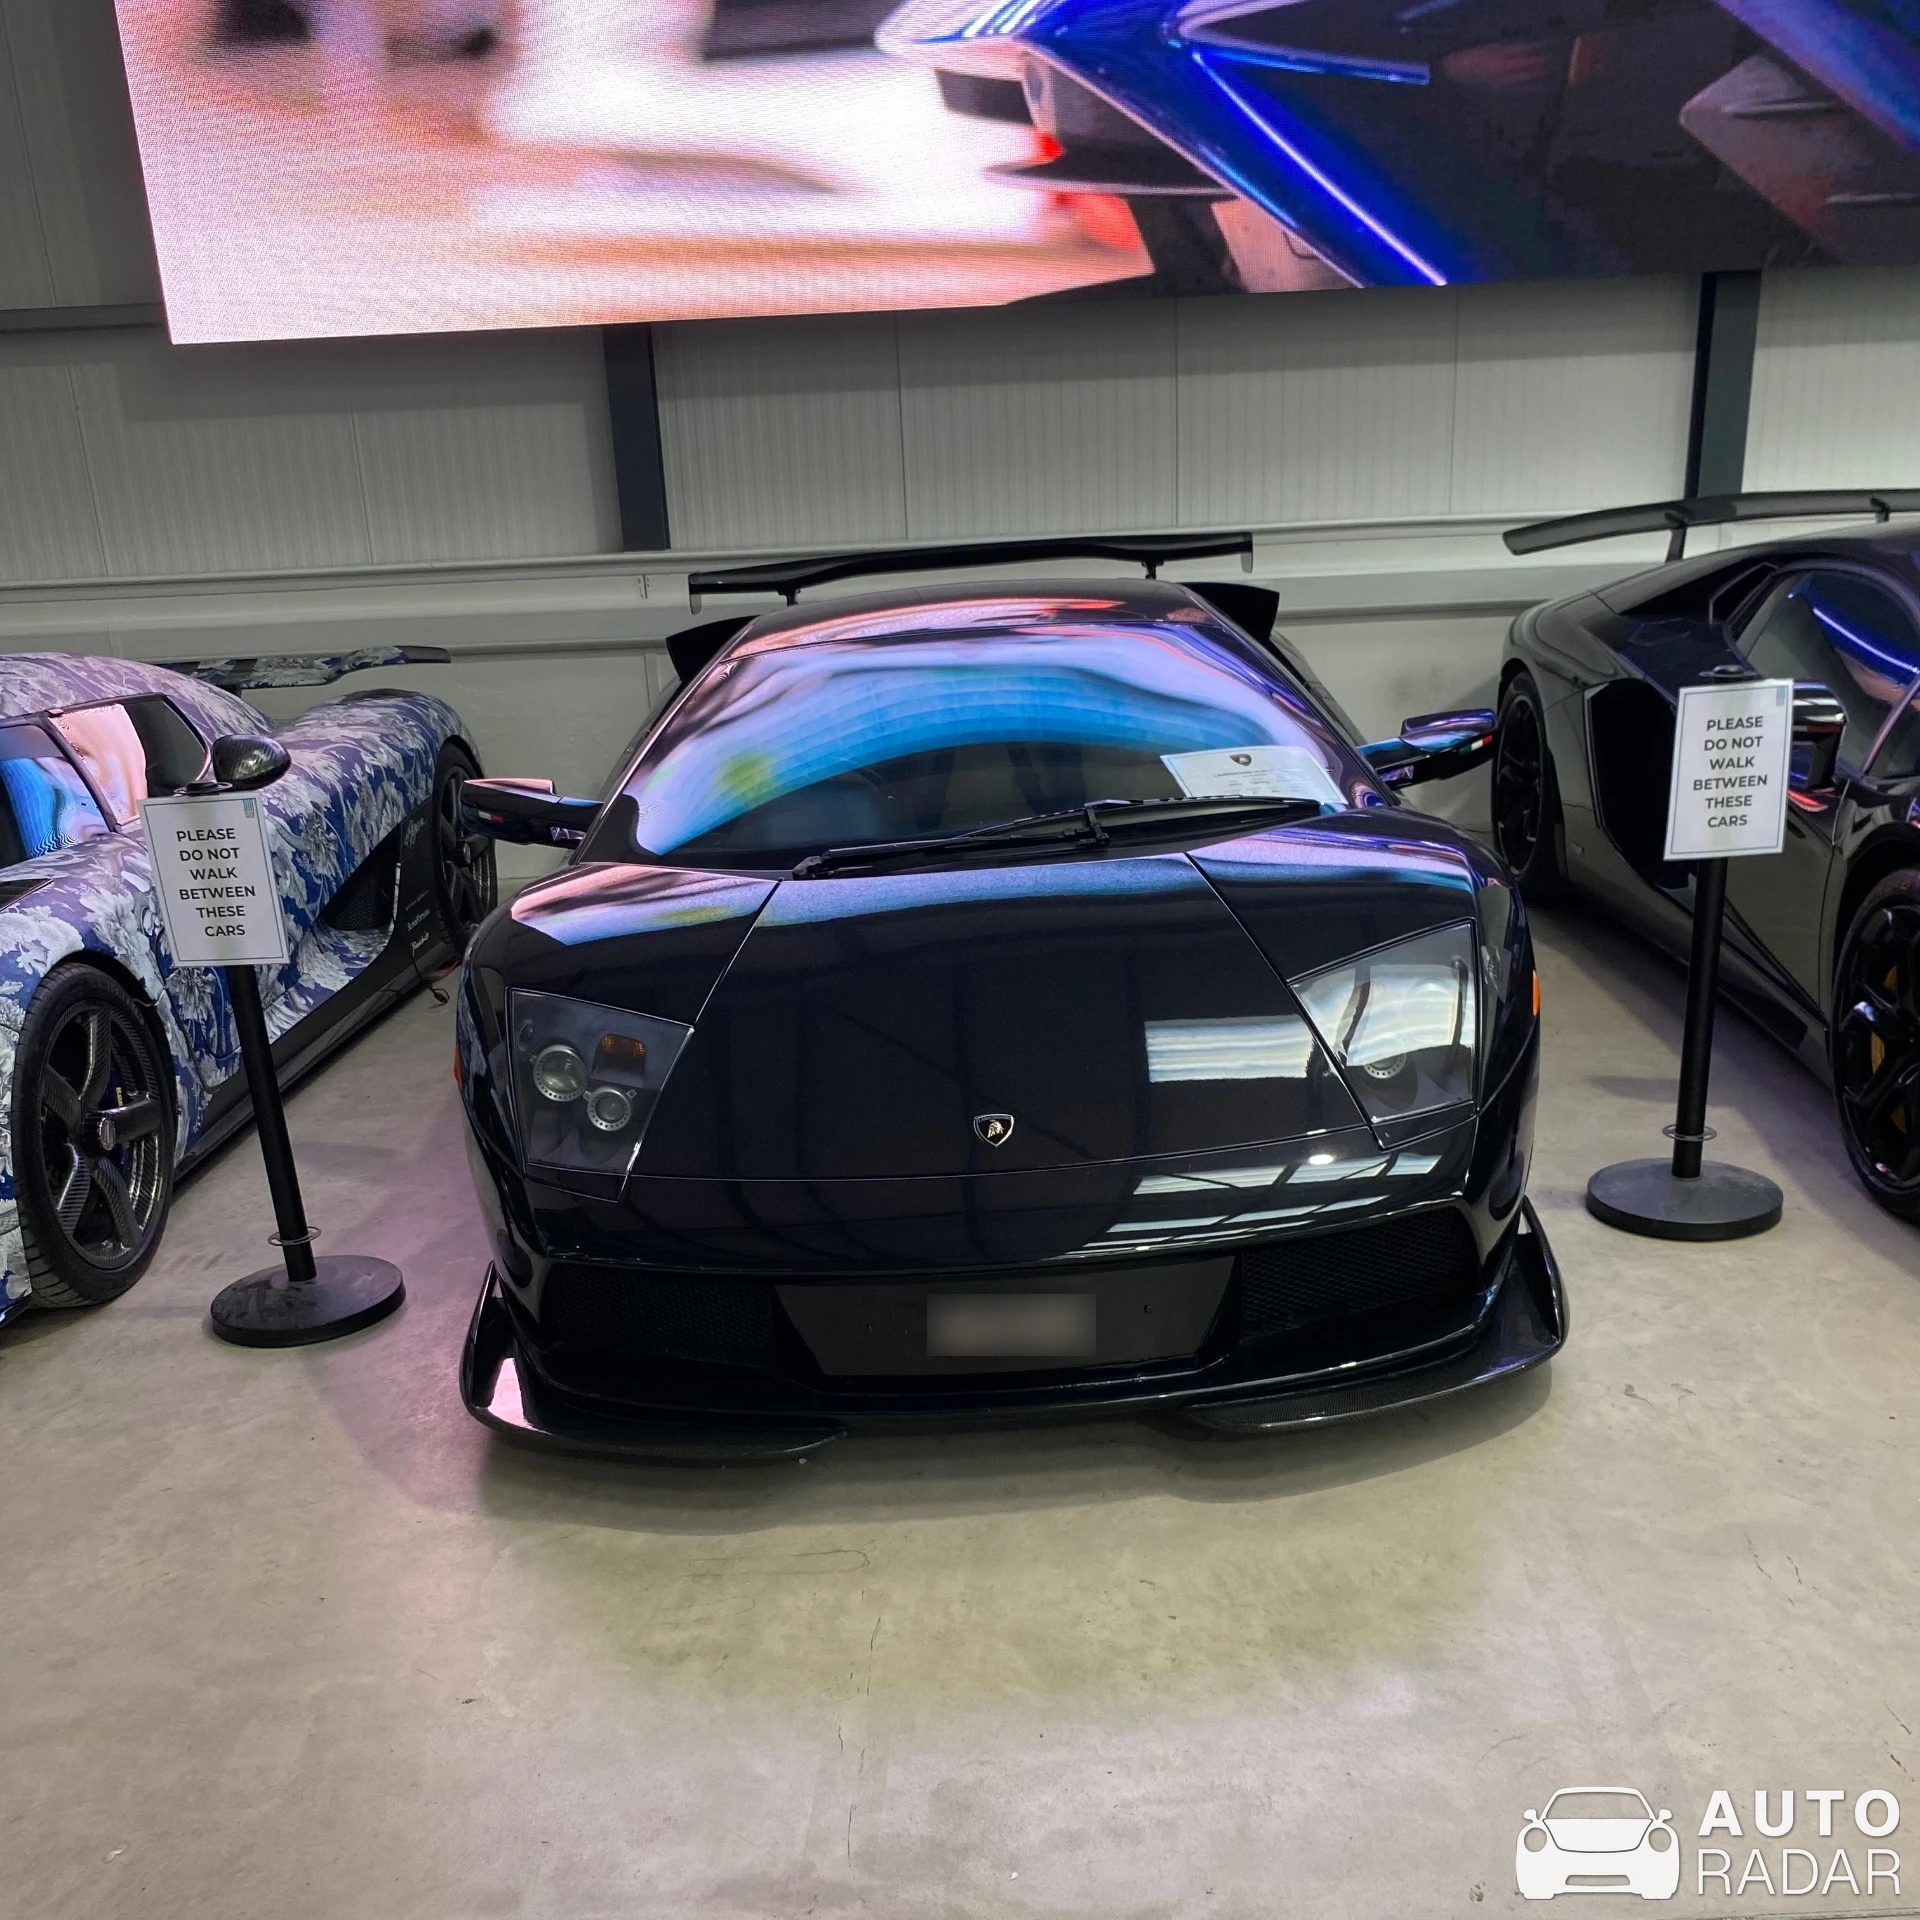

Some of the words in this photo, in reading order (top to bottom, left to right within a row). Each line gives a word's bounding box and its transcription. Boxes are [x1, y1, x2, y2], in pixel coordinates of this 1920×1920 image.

[1707, 716, 1763, 731] PLEASE
[1704, 739, 1727, 751] DO
[1732, 736, 1763, 749] NOT
[1710, 756, 1755, 770] WALK
[1693, 775, 1768, 791] BETWEEN
[1705, 795, 1752, 809] THESE
[1708, 815, 1748, 828] CARS
[177, 828, 236, 842] PLEASE
[180, 850, 203, 861] DO
[208, 848, 240, 860] NOT
[190, 867, 238, 880] WALK
[179, 886, 256, 900] BETWEEN
[196, 905, 246, 918] THESE
[205, 925, 245, 937] CARS
